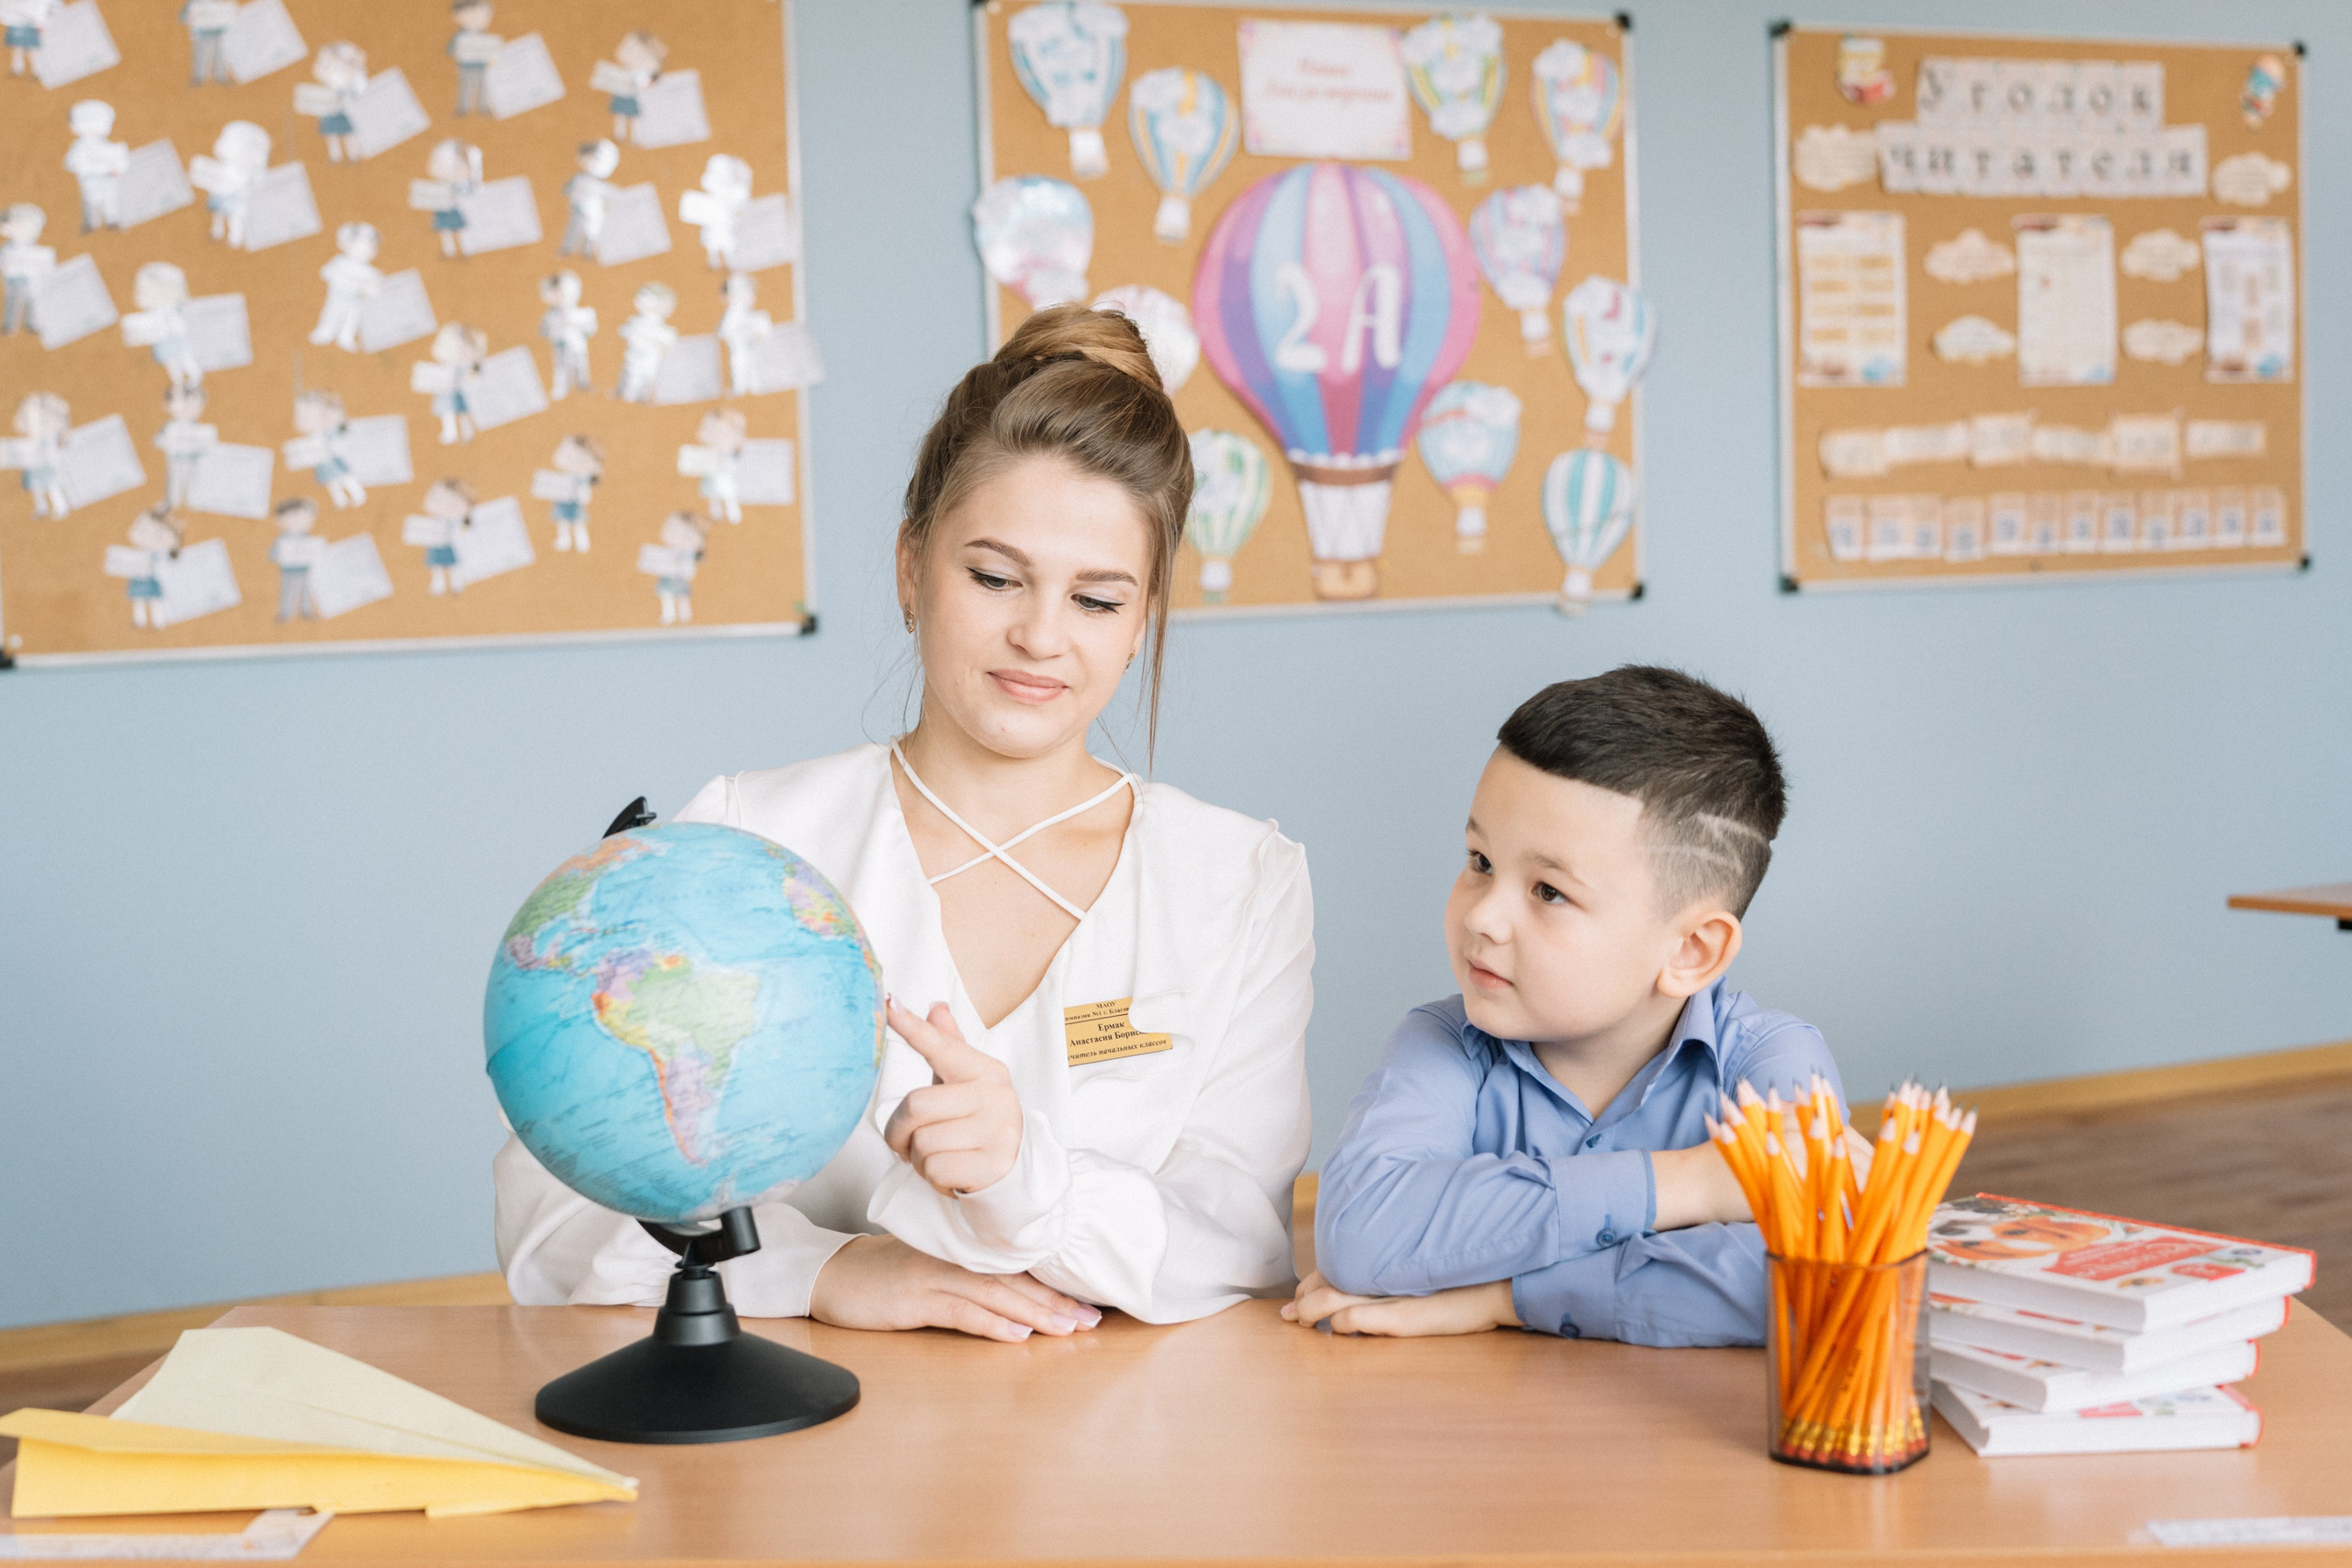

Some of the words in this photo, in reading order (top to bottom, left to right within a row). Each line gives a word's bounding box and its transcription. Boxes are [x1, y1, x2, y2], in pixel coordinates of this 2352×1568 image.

[1096, 1000, 1116, 1010] МАОУ
[1065, 1013, 1091, 1021] имназия
[1098, 1021, 1125, 1032] Ермак
[1069, 1033, 1113, 1047] Анастасия
[1098, 1043, 1138, 1055] начальных
[1139, 1039, 1167, 1049] классов
